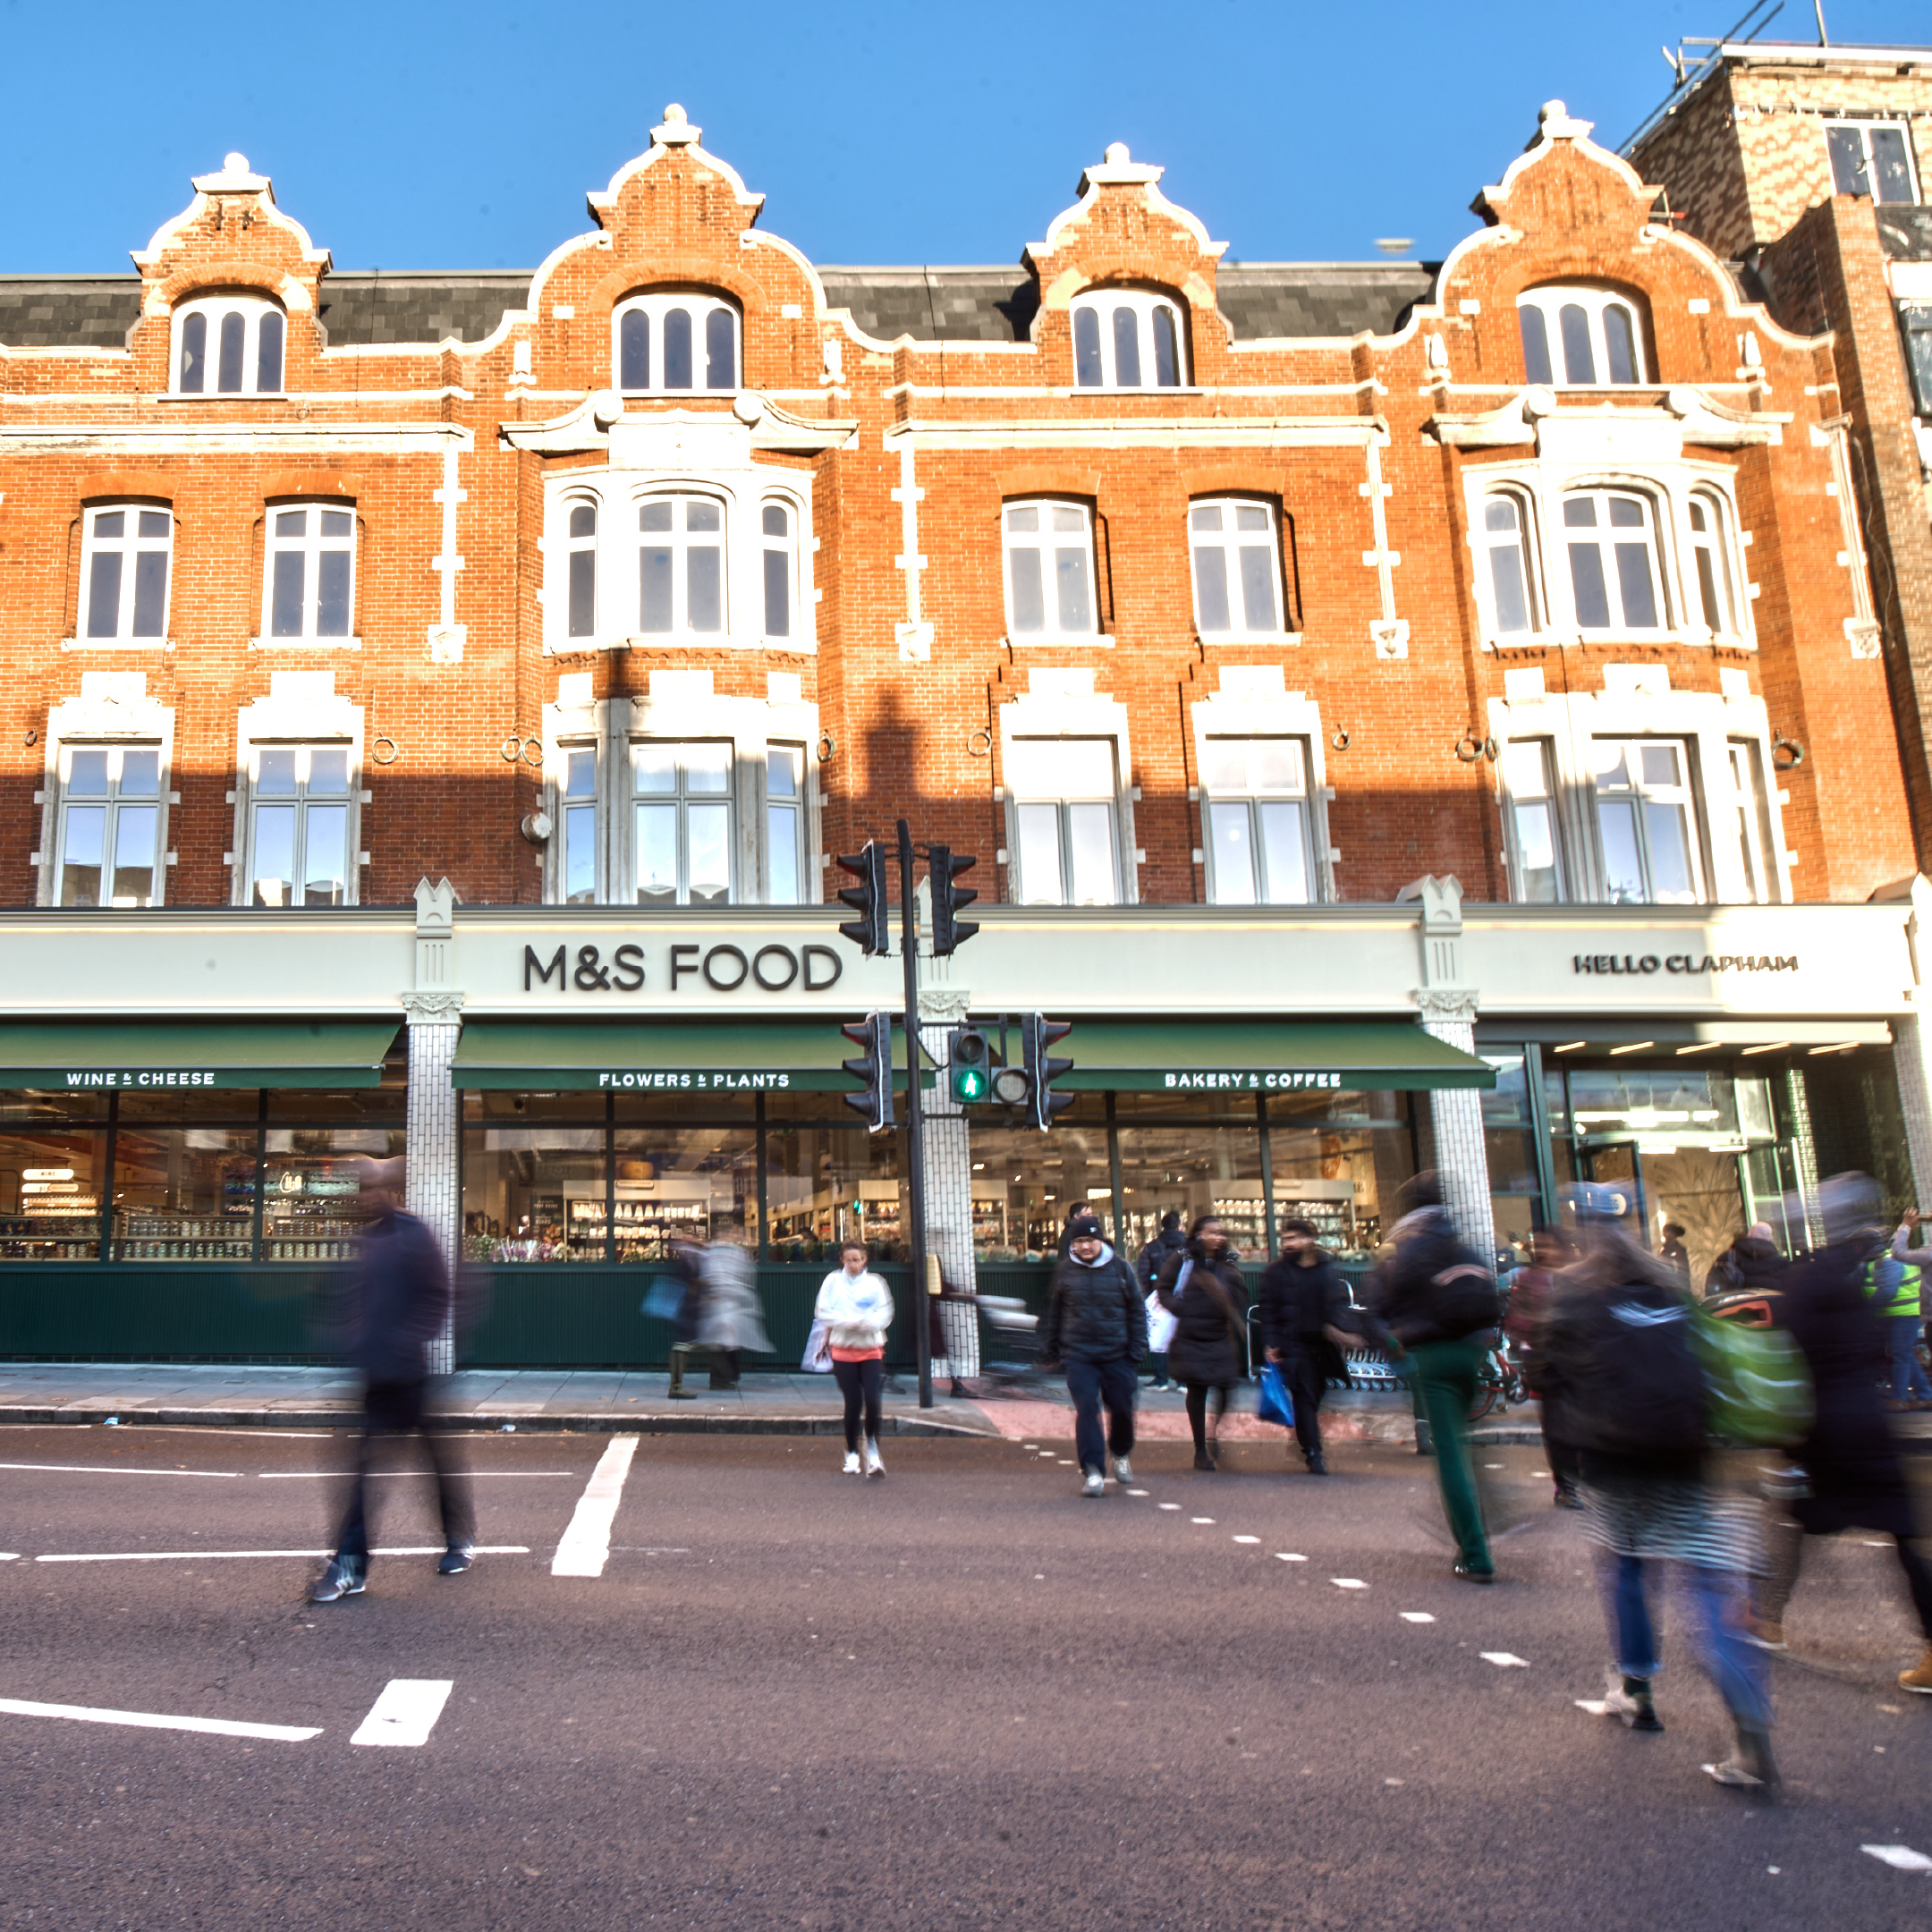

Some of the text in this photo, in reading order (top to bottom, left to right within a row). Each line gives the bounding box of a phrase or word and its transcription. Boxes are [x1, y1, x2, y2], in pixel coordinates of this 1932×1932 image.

[524, 944, 843, 991] M&S FOOD
[1573, 953, 1799, 974] HELLO CLAPHAM
[66, 1072, 215, 1086] WINE & CHEESE
[598, 1073, 790, 1088] FLOWERS & PLANTS
[1165, 1073, 1341, 1088] BAKERY & COFFEE
